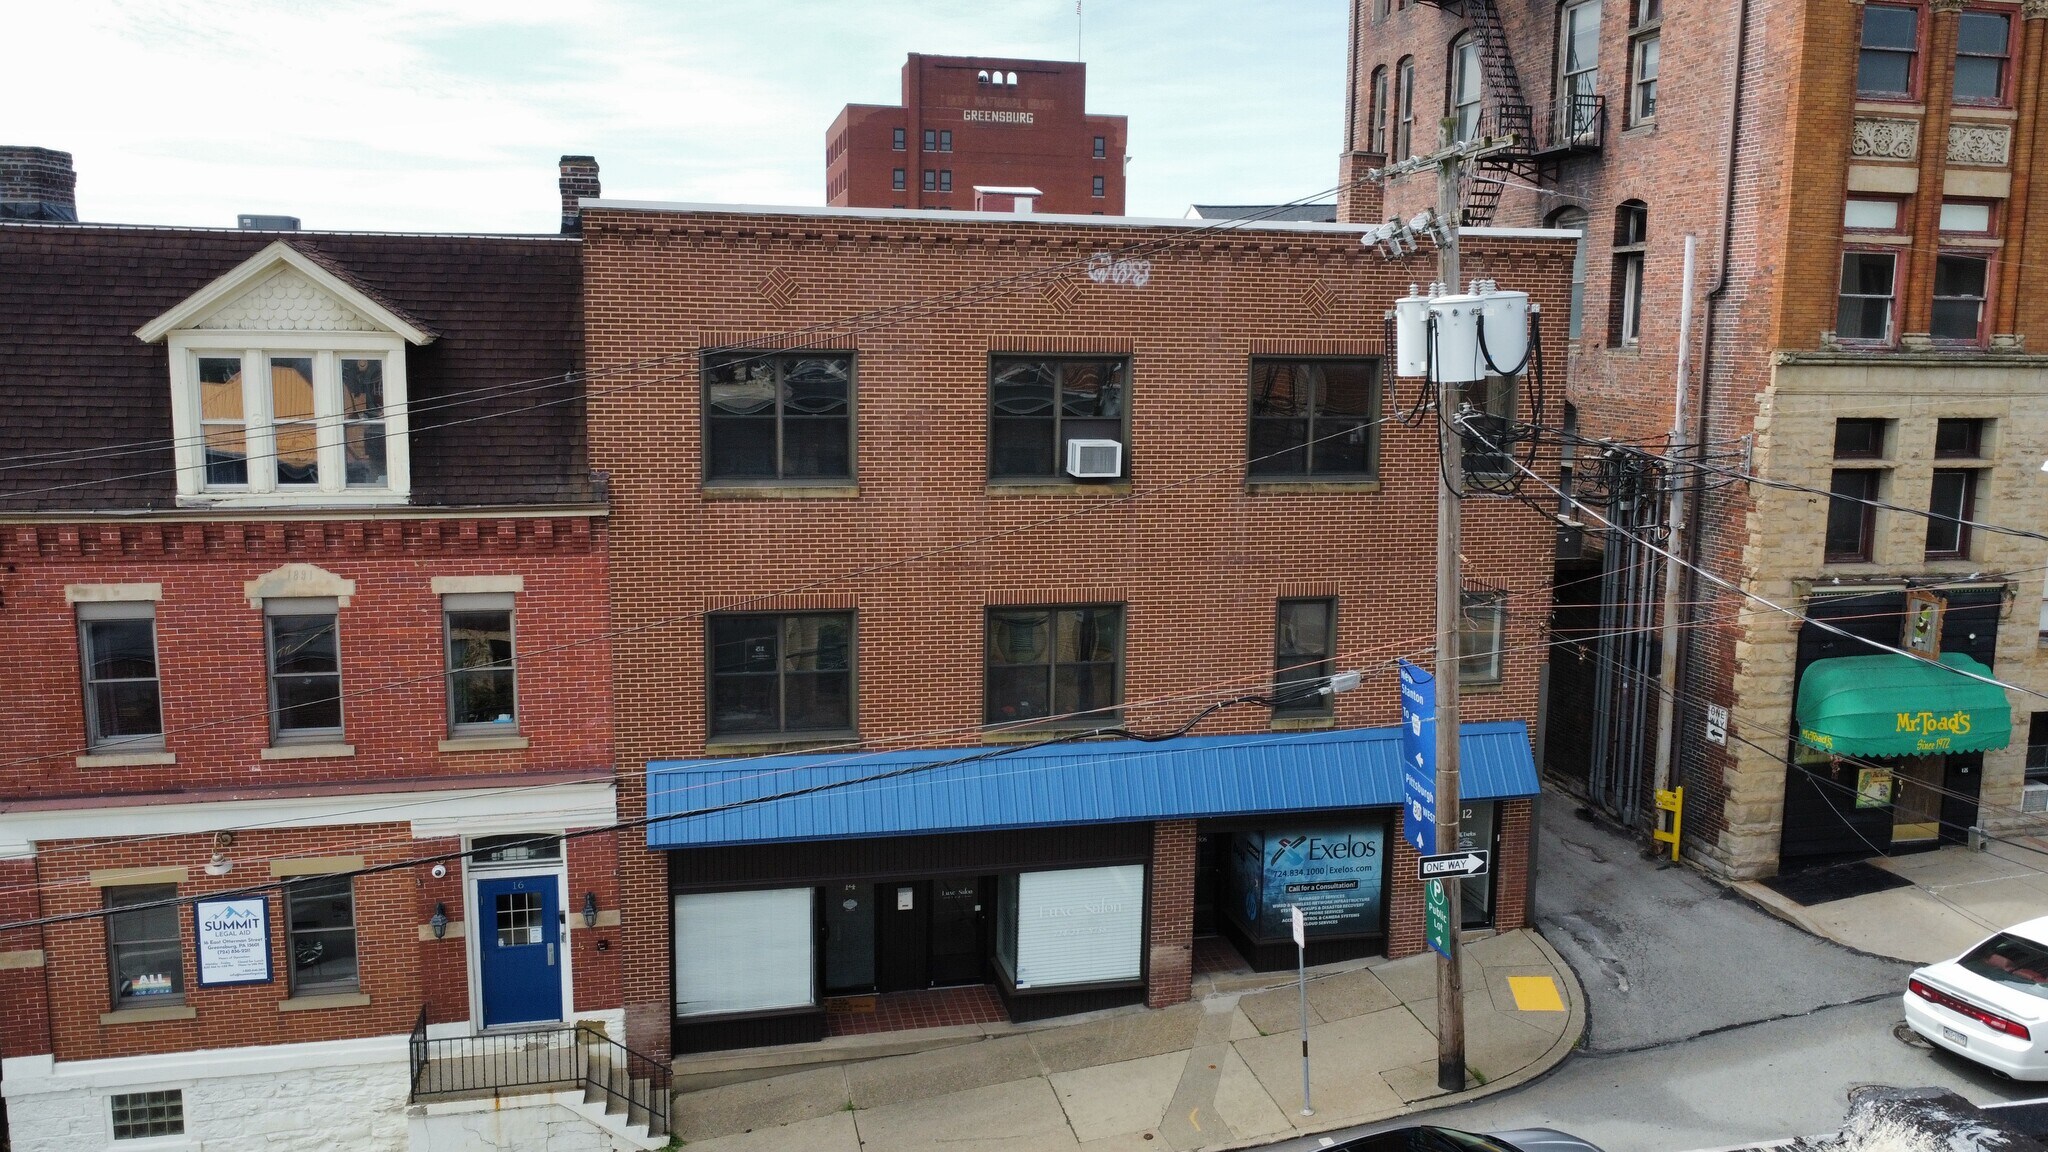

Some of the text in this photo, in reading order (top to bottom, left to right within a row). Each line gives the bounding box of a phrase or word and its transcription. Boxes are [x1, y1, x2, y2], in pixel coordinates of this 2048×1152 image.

[963, 109, 1034, 124] GREENSBURG
[287, 569, 313, 580] 1891
[1400, 669, 1414, 685] New
[1401, 684, 1424, 706] Stanton
[1403, 706, 1410, 719] To
[1710, 706, 1725, 720] ONE
[1710, 716, 1725, 728] WAY
[1917, 738, 1950, 750] Since 1972
[1406, 773, 1434, 804] Pittsburgh
[1406, 792, 1412, 806] To
[1423, 806, 1436, 824] WEST
[1462, 808, 1472, 818] 12
[1309, 834, 1376, 860] Exelos
[1274, 864, 1372, 878] 724.834.1000 Exelos.com
[1426, 860, 1467, 872] ONE WAY
[512, 882, 525, 890] 16
[1316, 882, 1356, 890] Consultation!
[1434, 883, 1441, 898] P
[1084, 896, 1122, 914] Salon
[1428, 902, 1446, 924] Public
[204, 918, 260, 932] SUMMIT
[1434, 919, 1444, 933] Lot
[139, 974, 166, 984] ALL
